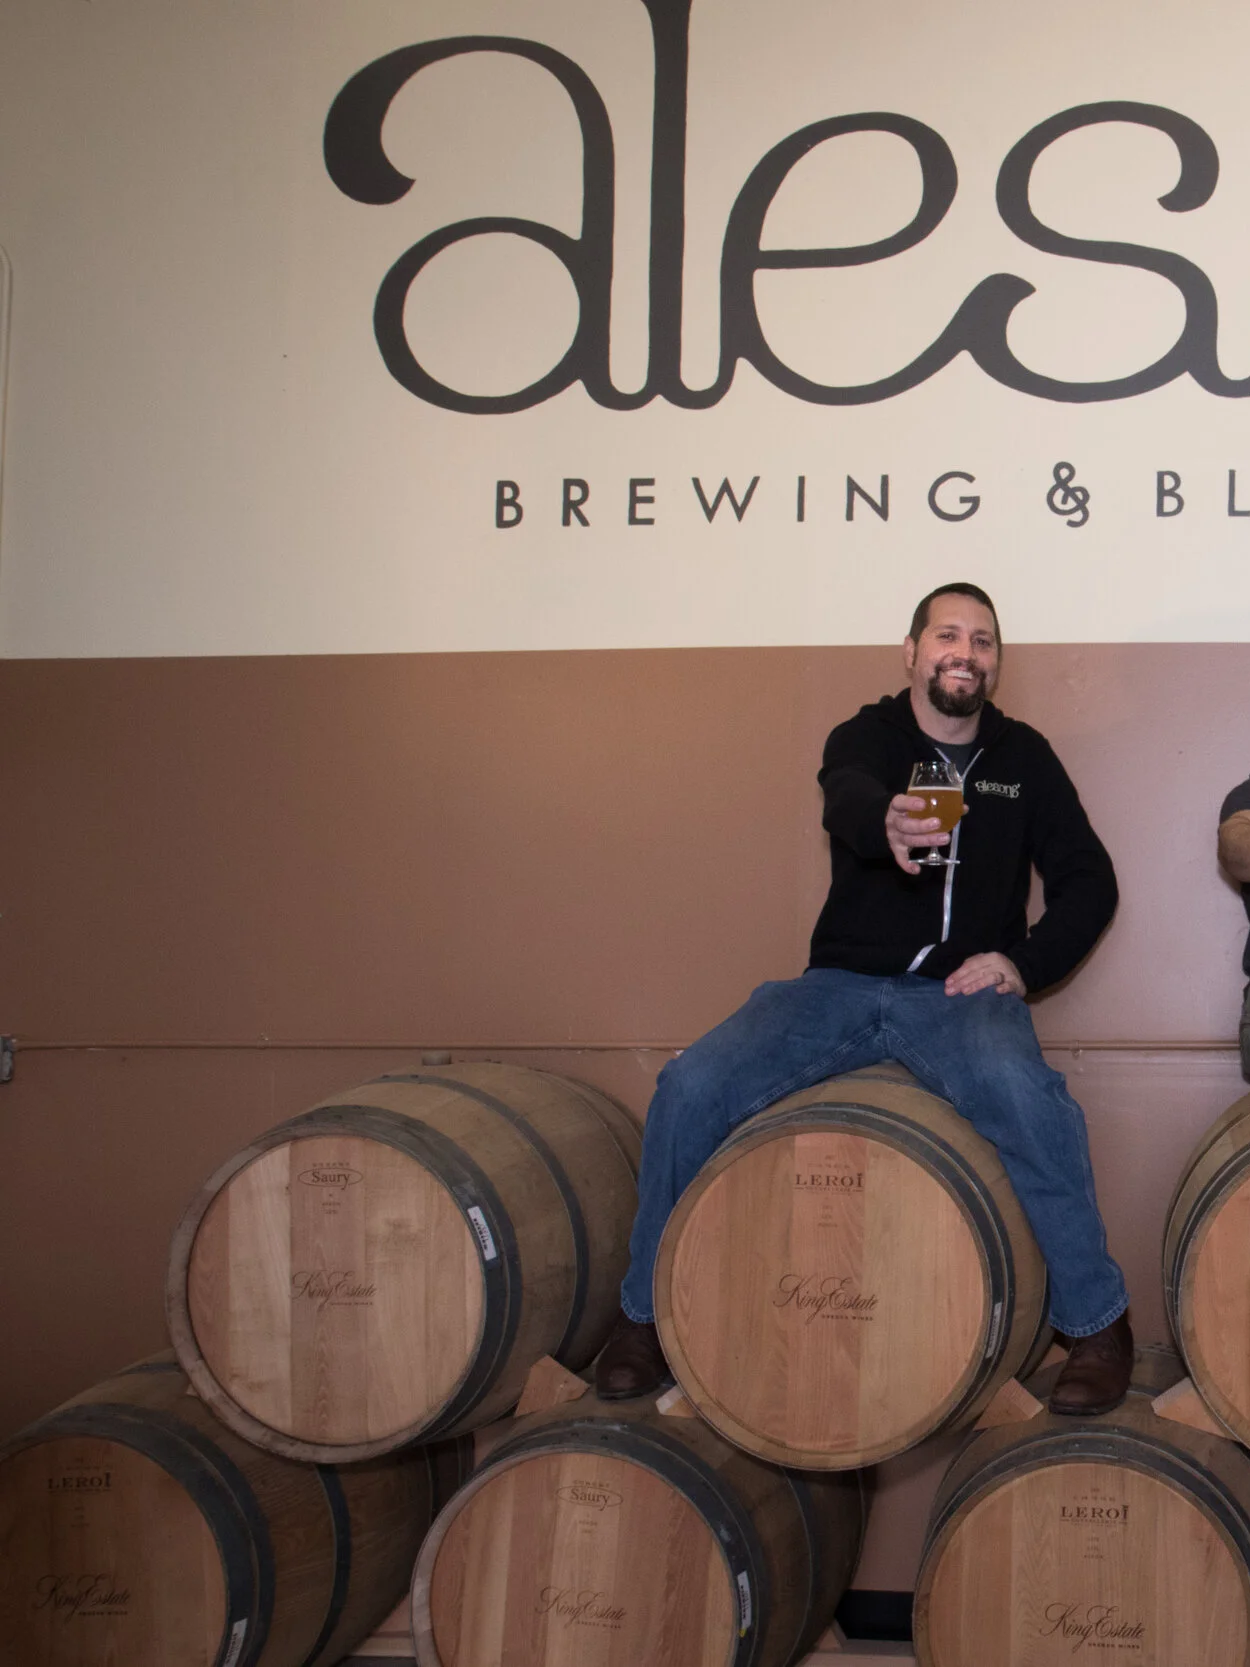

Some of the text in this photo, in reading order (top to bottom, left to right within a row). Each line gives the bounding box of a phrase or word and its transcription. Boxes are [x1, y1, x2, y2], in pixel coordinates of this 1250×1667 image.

[495, 470, 981, 529] BREWING
[1046, 461, 1091, 528] &
[311, 1170, 352, 1192] Saury
[570, 1487, 611, 1512] Saury
